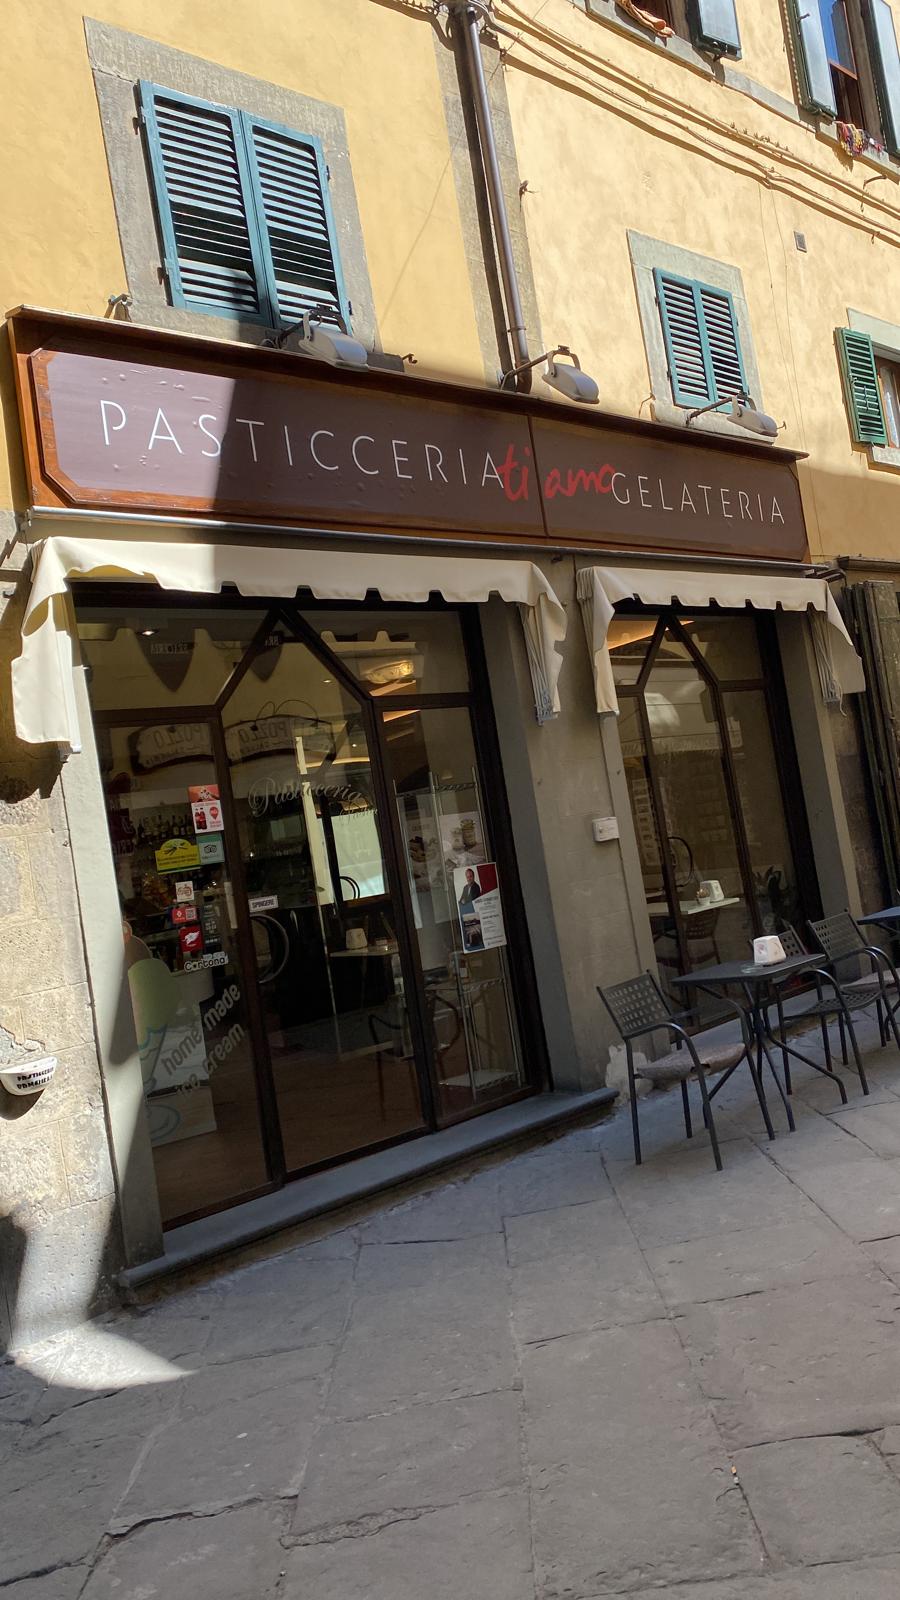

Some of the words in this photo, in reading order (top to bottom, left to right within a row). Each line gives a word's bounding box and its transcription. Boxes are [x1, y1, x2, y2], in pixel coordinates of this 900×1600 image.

[100, 400, 505, 489] PASTICCERIA
[498, 443, 532, 502] ti
[544, 463, 617, 500] amo
[611, 471, 786, 525] GELATERIA
[162, 1030, 202, 1076] home
[203, 984, 241, 1032] made
[202, 1023, 246, 1075] cream
